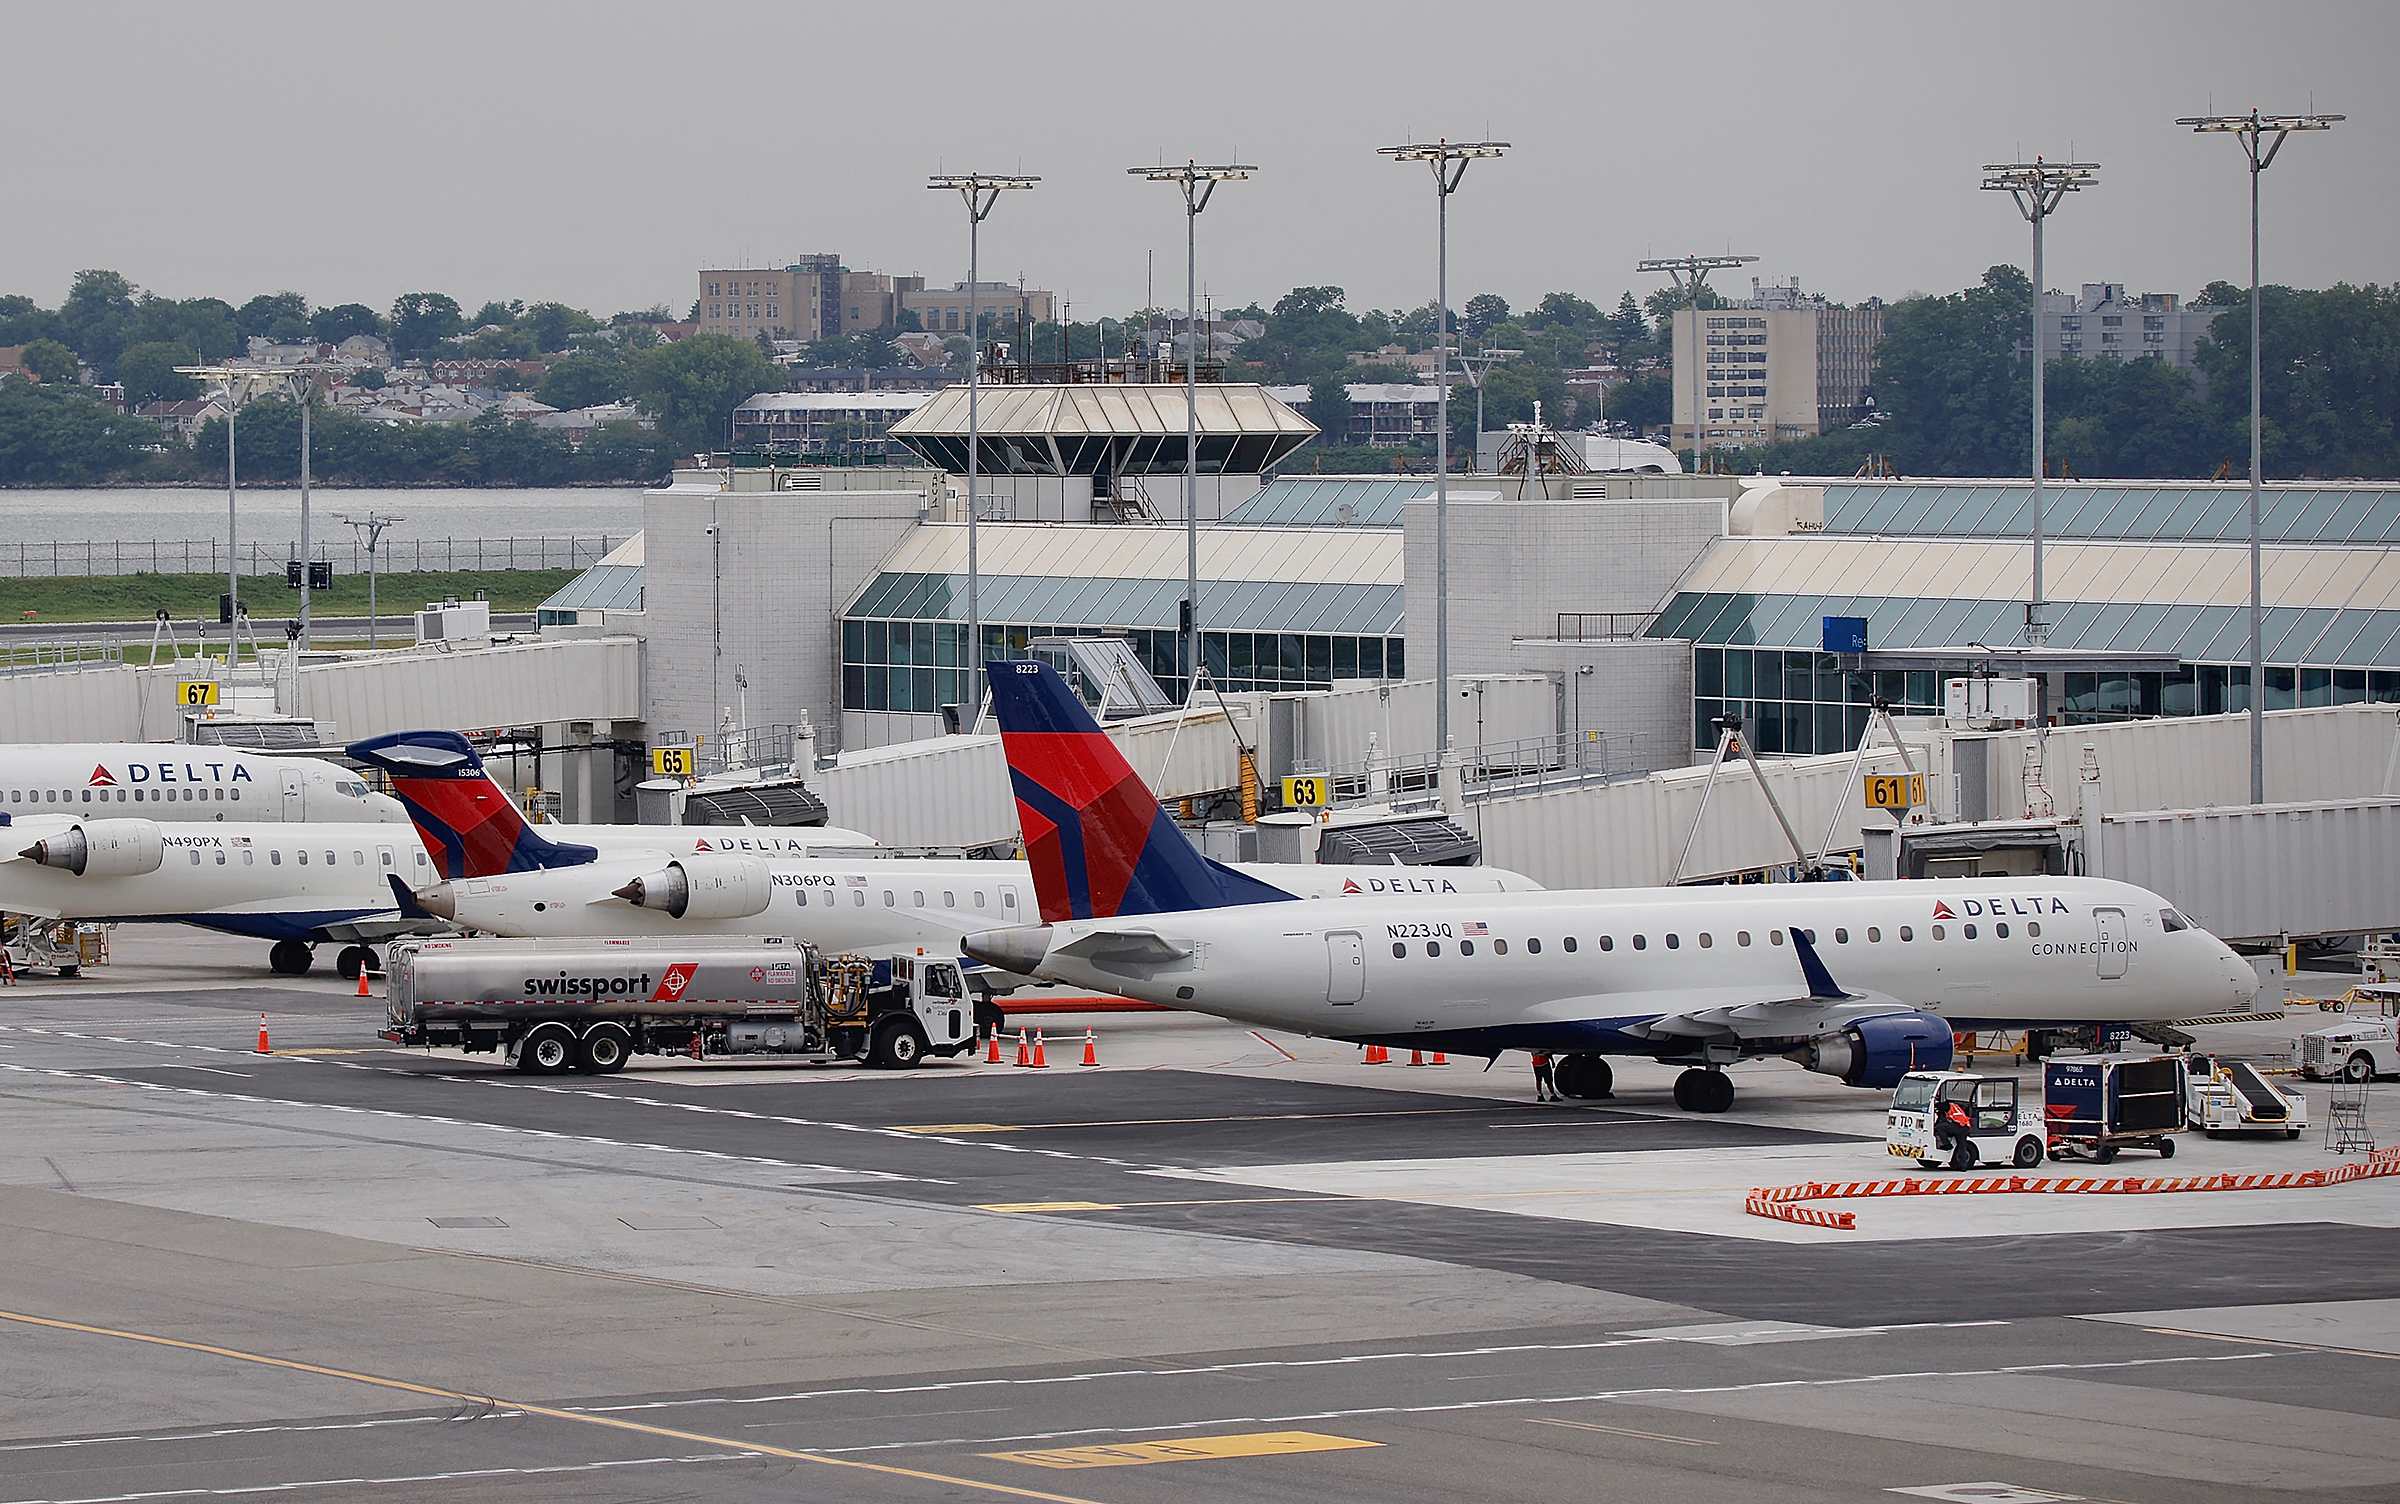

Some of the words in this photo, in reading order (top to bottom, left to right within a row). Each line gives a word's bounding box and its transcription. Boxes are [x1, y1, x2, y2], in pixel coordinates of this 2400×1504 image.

[1015, 664, 1039, 674] 8223
[187, 684, 210, 706] 67
[662, 749, 684, 775] 65
[127, 763, 253, 782] DELTA
[458, 768, 481, 777] 15306
[1293, 778, 1316, 805] 63
[1874, 778, 1899, 805] 61
[1912, 774, 1924, 803] 61
[162, 836, 223, 848] N490PX
[719, 838, 802, 851] DELTA
[771, 874, 836, 887] N306PQ
[1367, 878, 1457, 894] DELTA
[1962, 897, 2070, 917] DELTA
[1386, 923, 1453, 939] N223JQ
[2031, 941, 2138, 956] CONNECTION
[523, 970, 651, 1001] swissport
[2109, 1030, 2130, 1041] 8223
[2063, 1078, 2096, 1087] DELTA
